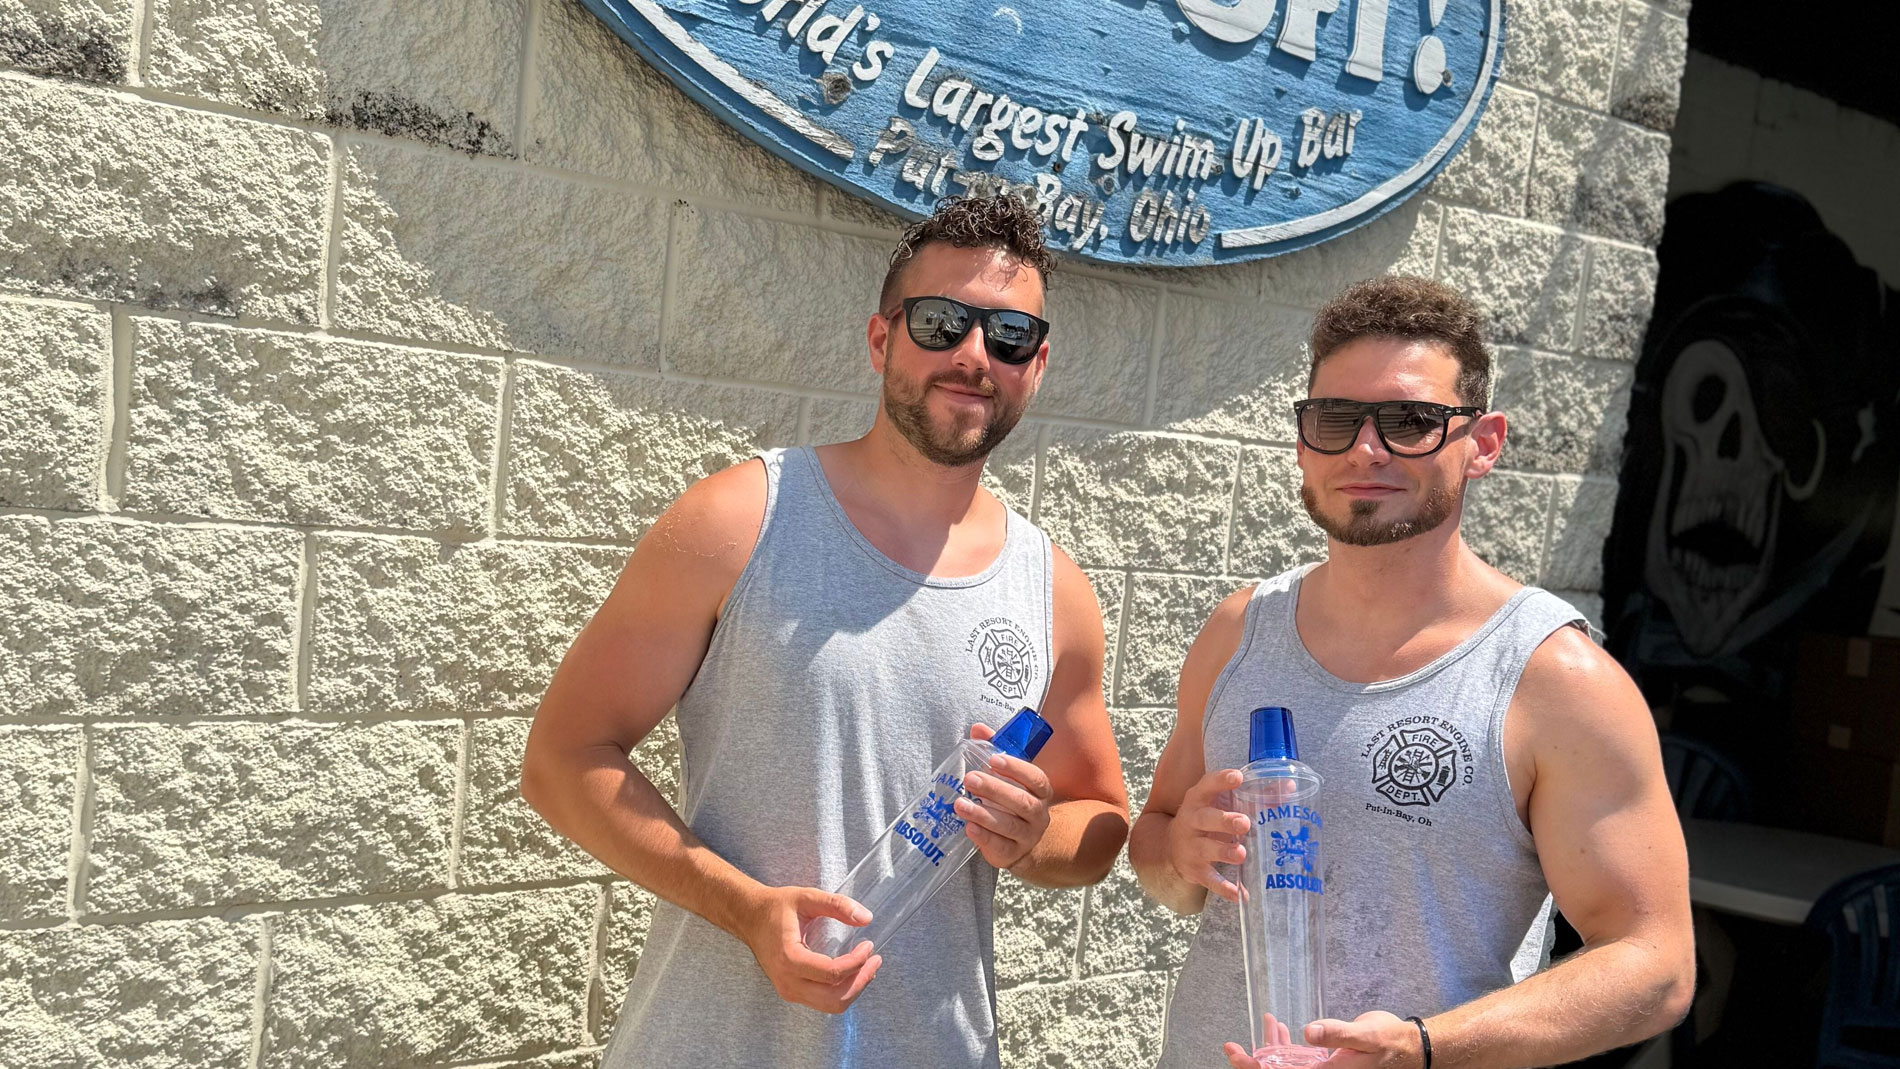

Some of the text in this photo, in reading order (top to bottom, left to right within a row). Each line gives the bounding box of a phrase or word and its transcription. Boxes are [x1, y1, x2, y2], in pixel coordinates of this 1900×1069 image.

[738, 0, 893, 81] ld's
[905, 47, 1089, 162] Largest
[1098, 111, 1215, 180] Swim
[1232, 118, 1282, 191] Up
[1297, 108, 1362, 168] Bar
[868, 116, 1211, 250] Put-Bay, Ohio
[965, 627, 981, 653] LAST
[979, 617, 1013, 630] RESORT
[1001, 634, 1019, 646] FIRE
[1361, 716, 1474, 786] LAST RESORT ENGINE CO.
[1412, 734, 1438, 748] FIRE
[1386, 785, 1421, 801] DEPT.
[1258, 805, 1323, 829] JAMESO
[1365, 803, 1433, 827] Put-In-Bay, Oh
[893, 820, 945, 867] ABSOLUT.
